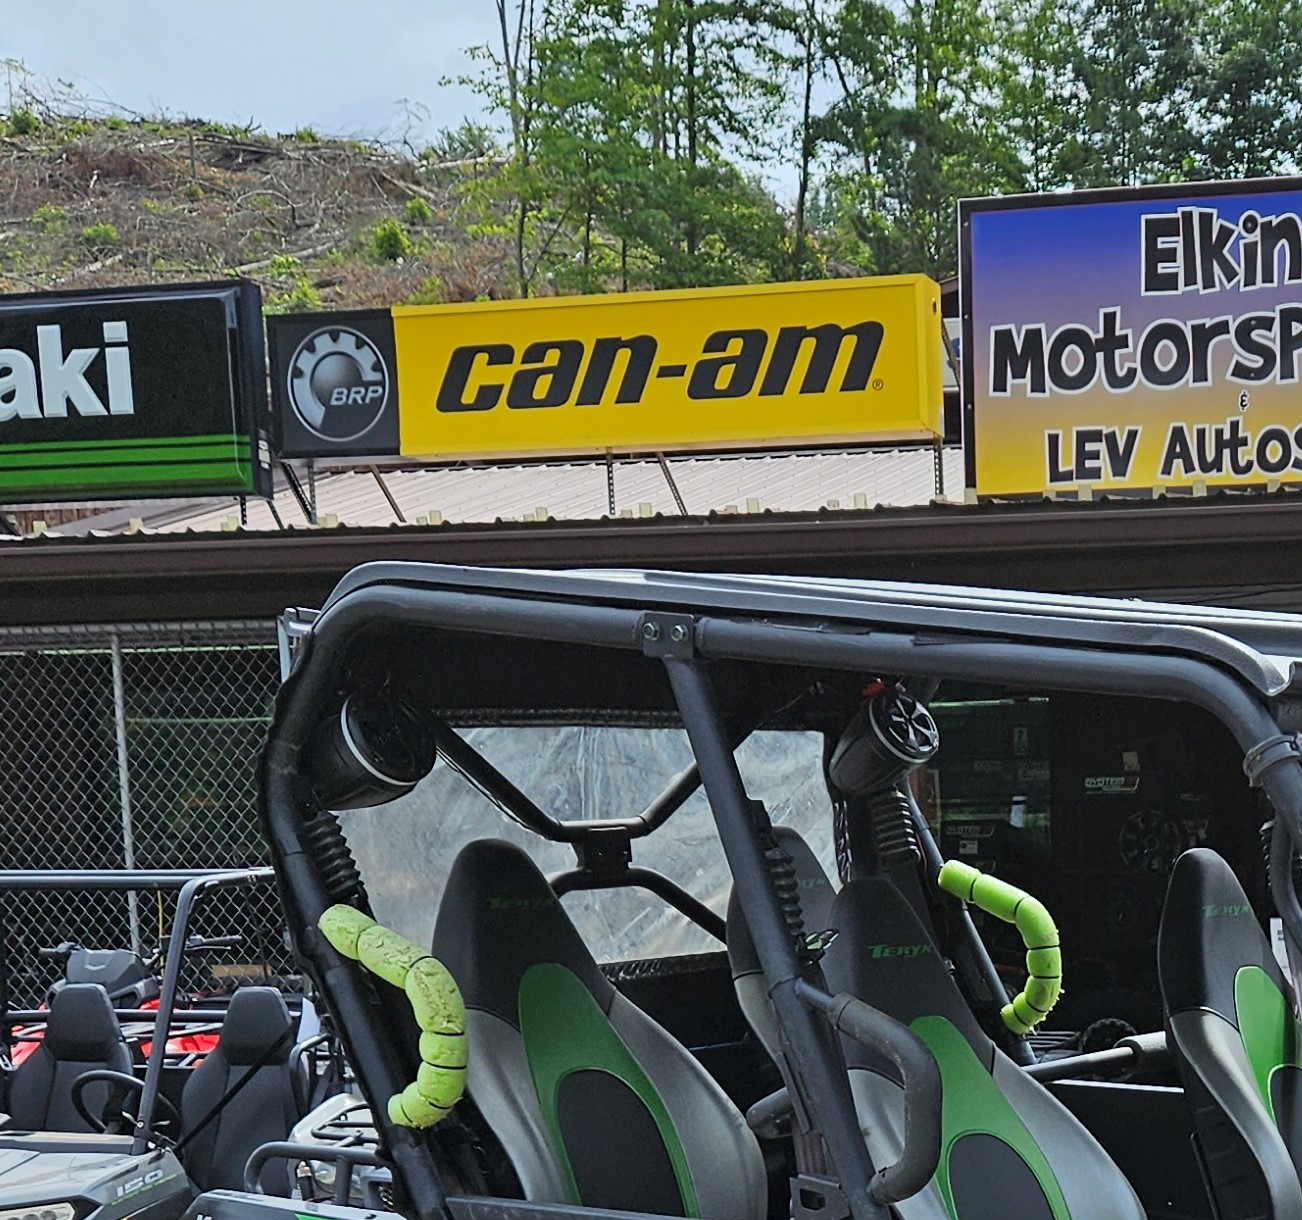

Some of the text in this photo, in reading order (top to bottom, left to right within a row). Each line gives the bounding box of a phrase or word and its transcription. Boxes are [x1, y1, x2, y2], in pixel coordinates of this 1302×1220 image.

[330, 385, 383, 406] BRP
[1045, 425, 1142, 483] LEV
[117, 1170, 163, 1197] 150
